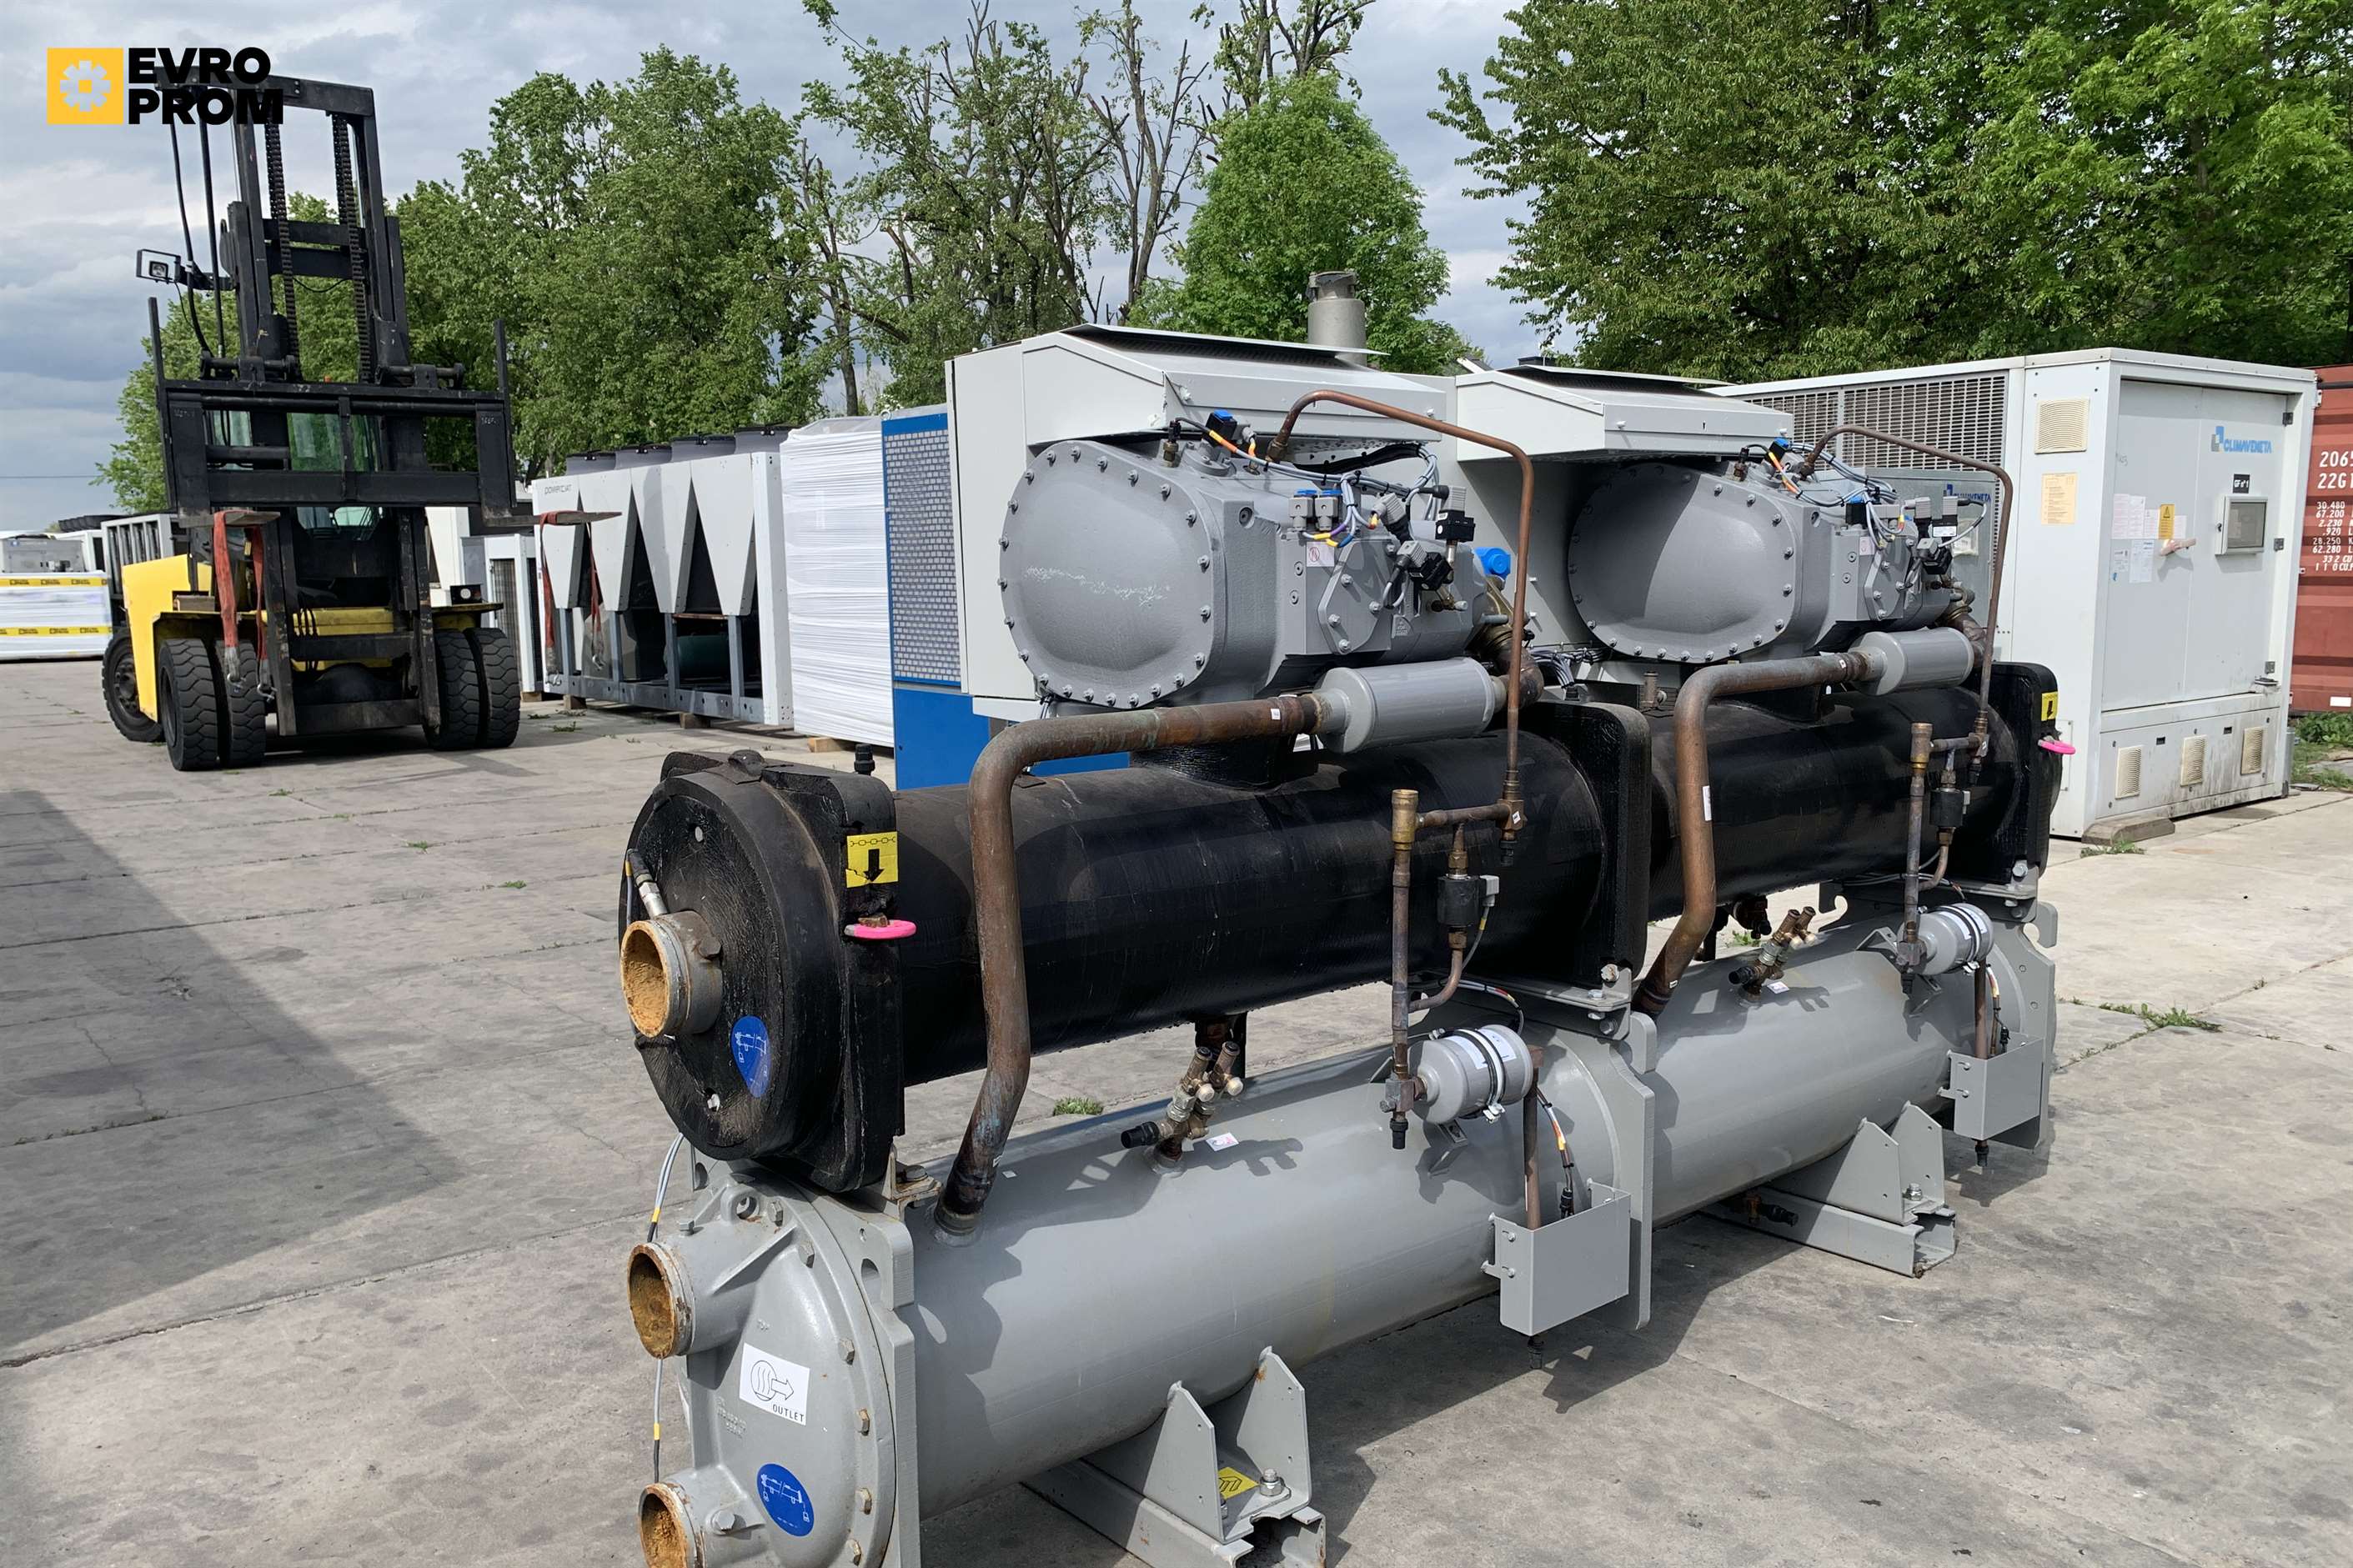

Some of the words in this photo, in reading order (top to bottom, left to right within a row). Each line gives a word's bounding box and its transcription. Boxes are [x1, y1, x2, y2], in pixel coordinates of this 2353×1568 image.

[2224, 439, 2272, 453] CLIMAVENETA
[2315, 509, 2345, 518] 67.200
[2313, 537, 2341, 545] 28.250
[2312, 545, 2341, 554] 62.280
[772, 1404, 805, 1422] OUTLET
